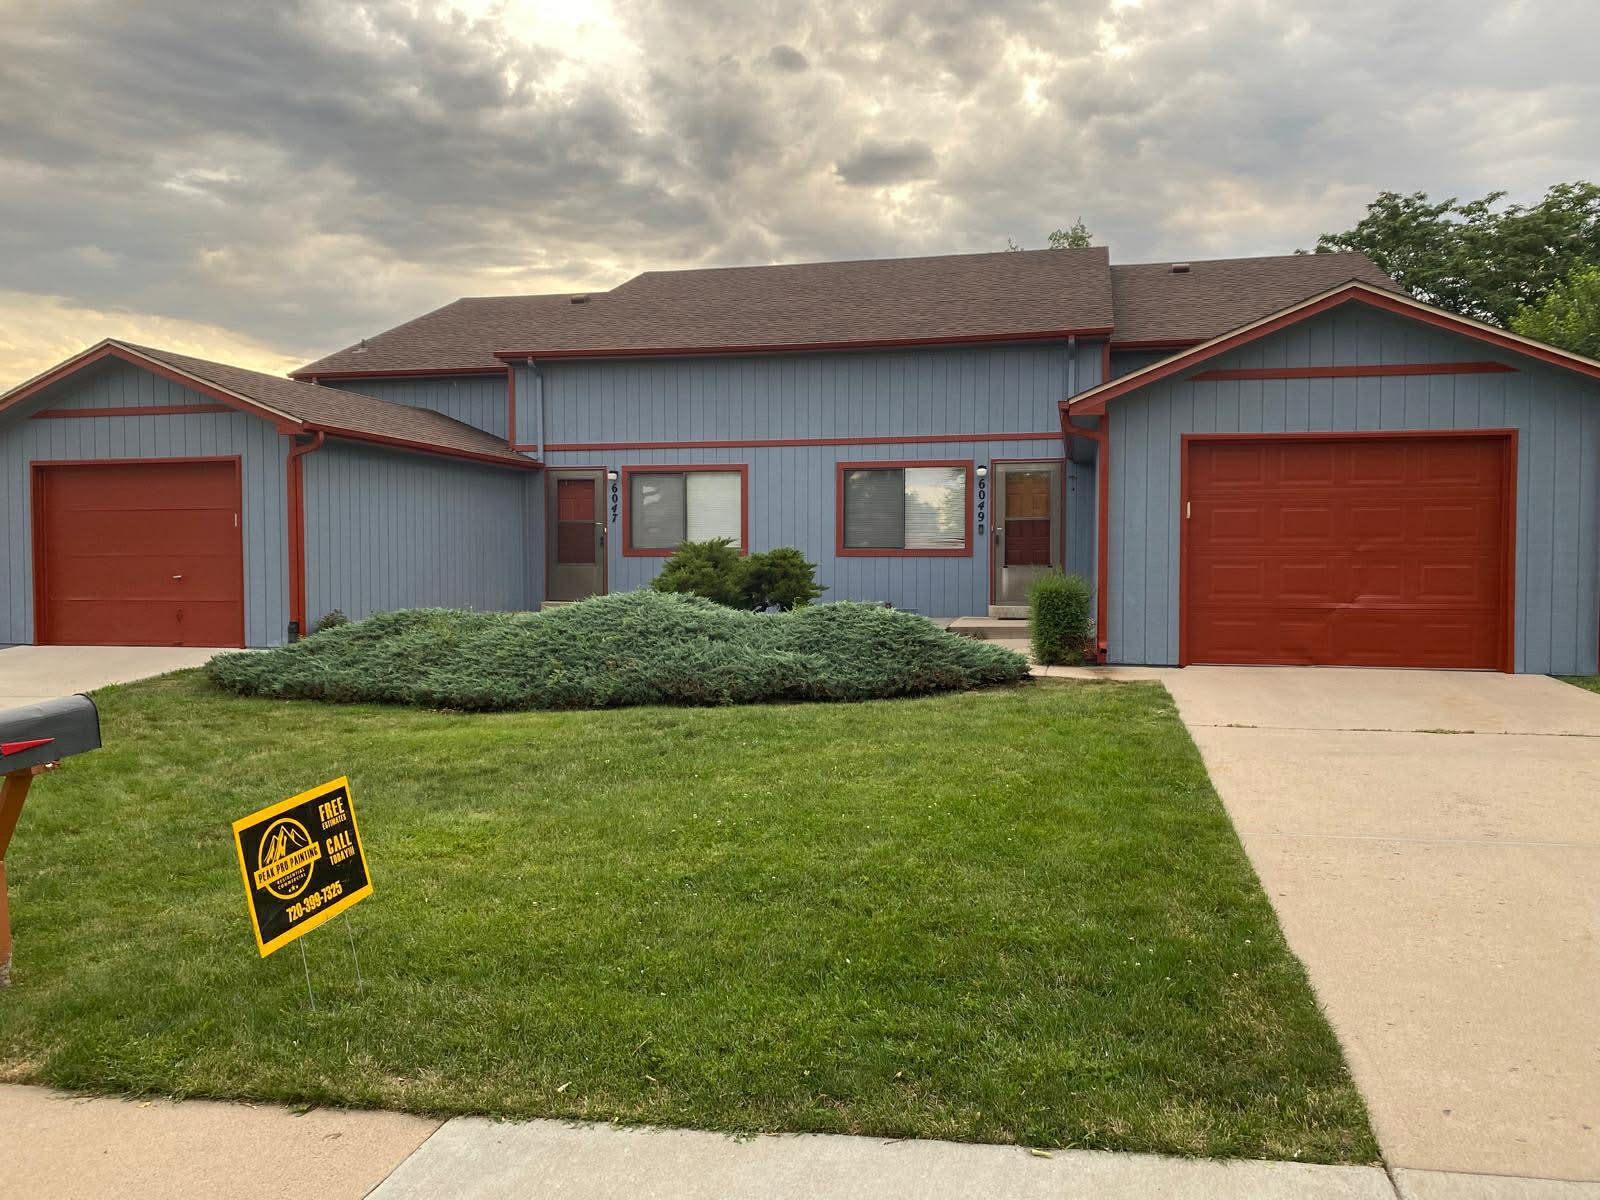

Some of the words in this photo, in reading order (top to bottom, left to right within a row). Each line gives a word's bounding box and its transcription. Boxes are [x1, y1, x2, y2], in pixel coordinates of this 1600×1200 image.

[318, 796, 345, 822] FREE
[321, 813, 347, 830] ESTIMATES
[326, 830, 352, 855] CALL
[258, 867, 275, 883] PEAK
[276, 860, 289, 875] PRO
[290, 846, 319, 867] PAINTING
[277, 868, 305, 885] RESIDENTIAL
[277, 872, 306, 890] COMMERCIAL
[286, 880, 343, 923] 720-399-7325
